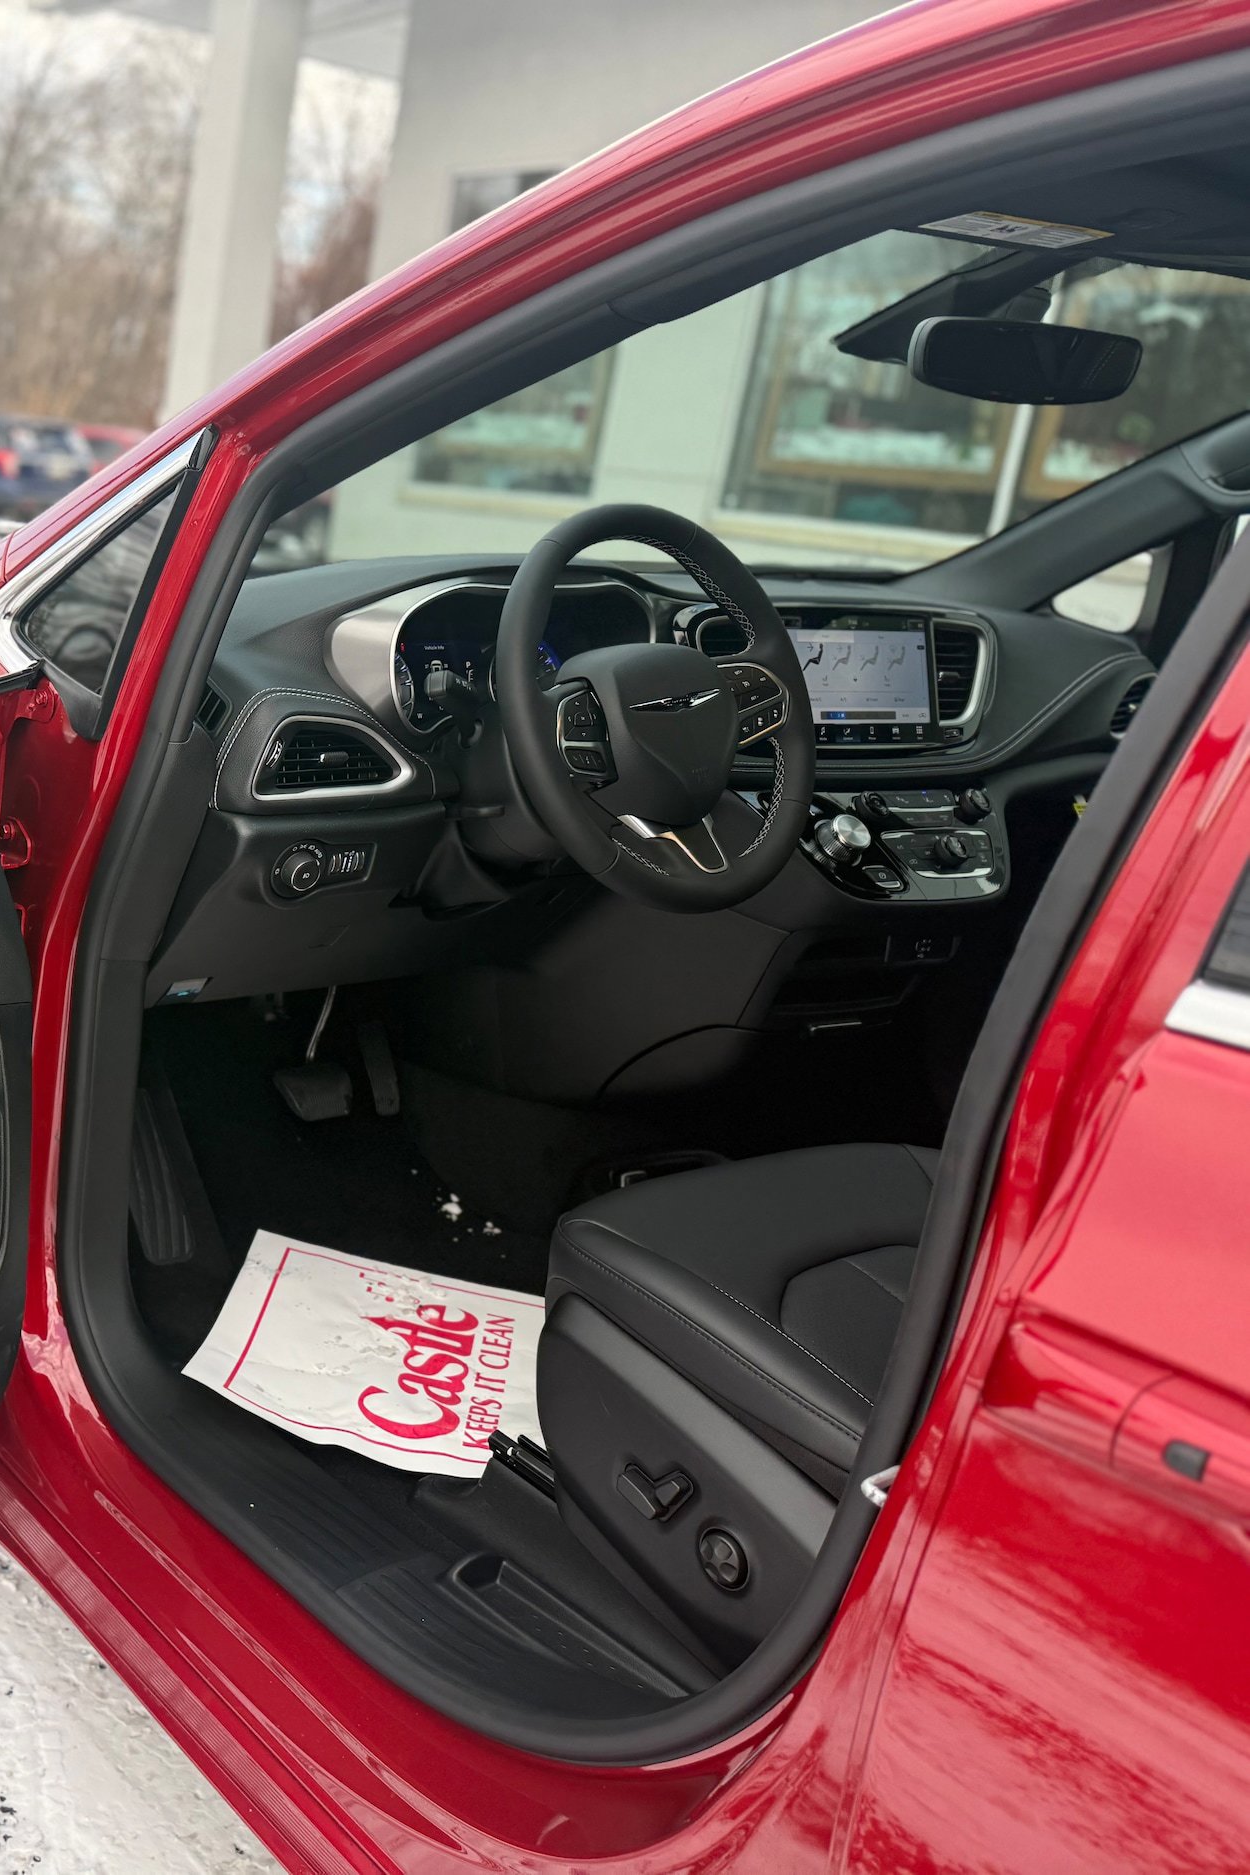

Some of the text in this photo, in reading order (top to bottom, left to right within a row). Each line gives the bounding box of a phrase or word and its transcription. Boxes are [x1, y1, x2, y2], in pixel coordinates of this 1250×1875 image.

[357, 1304, 479, 1439] Castle
[462, 1313, 516, 1449] KEEPS IT CLEAN
